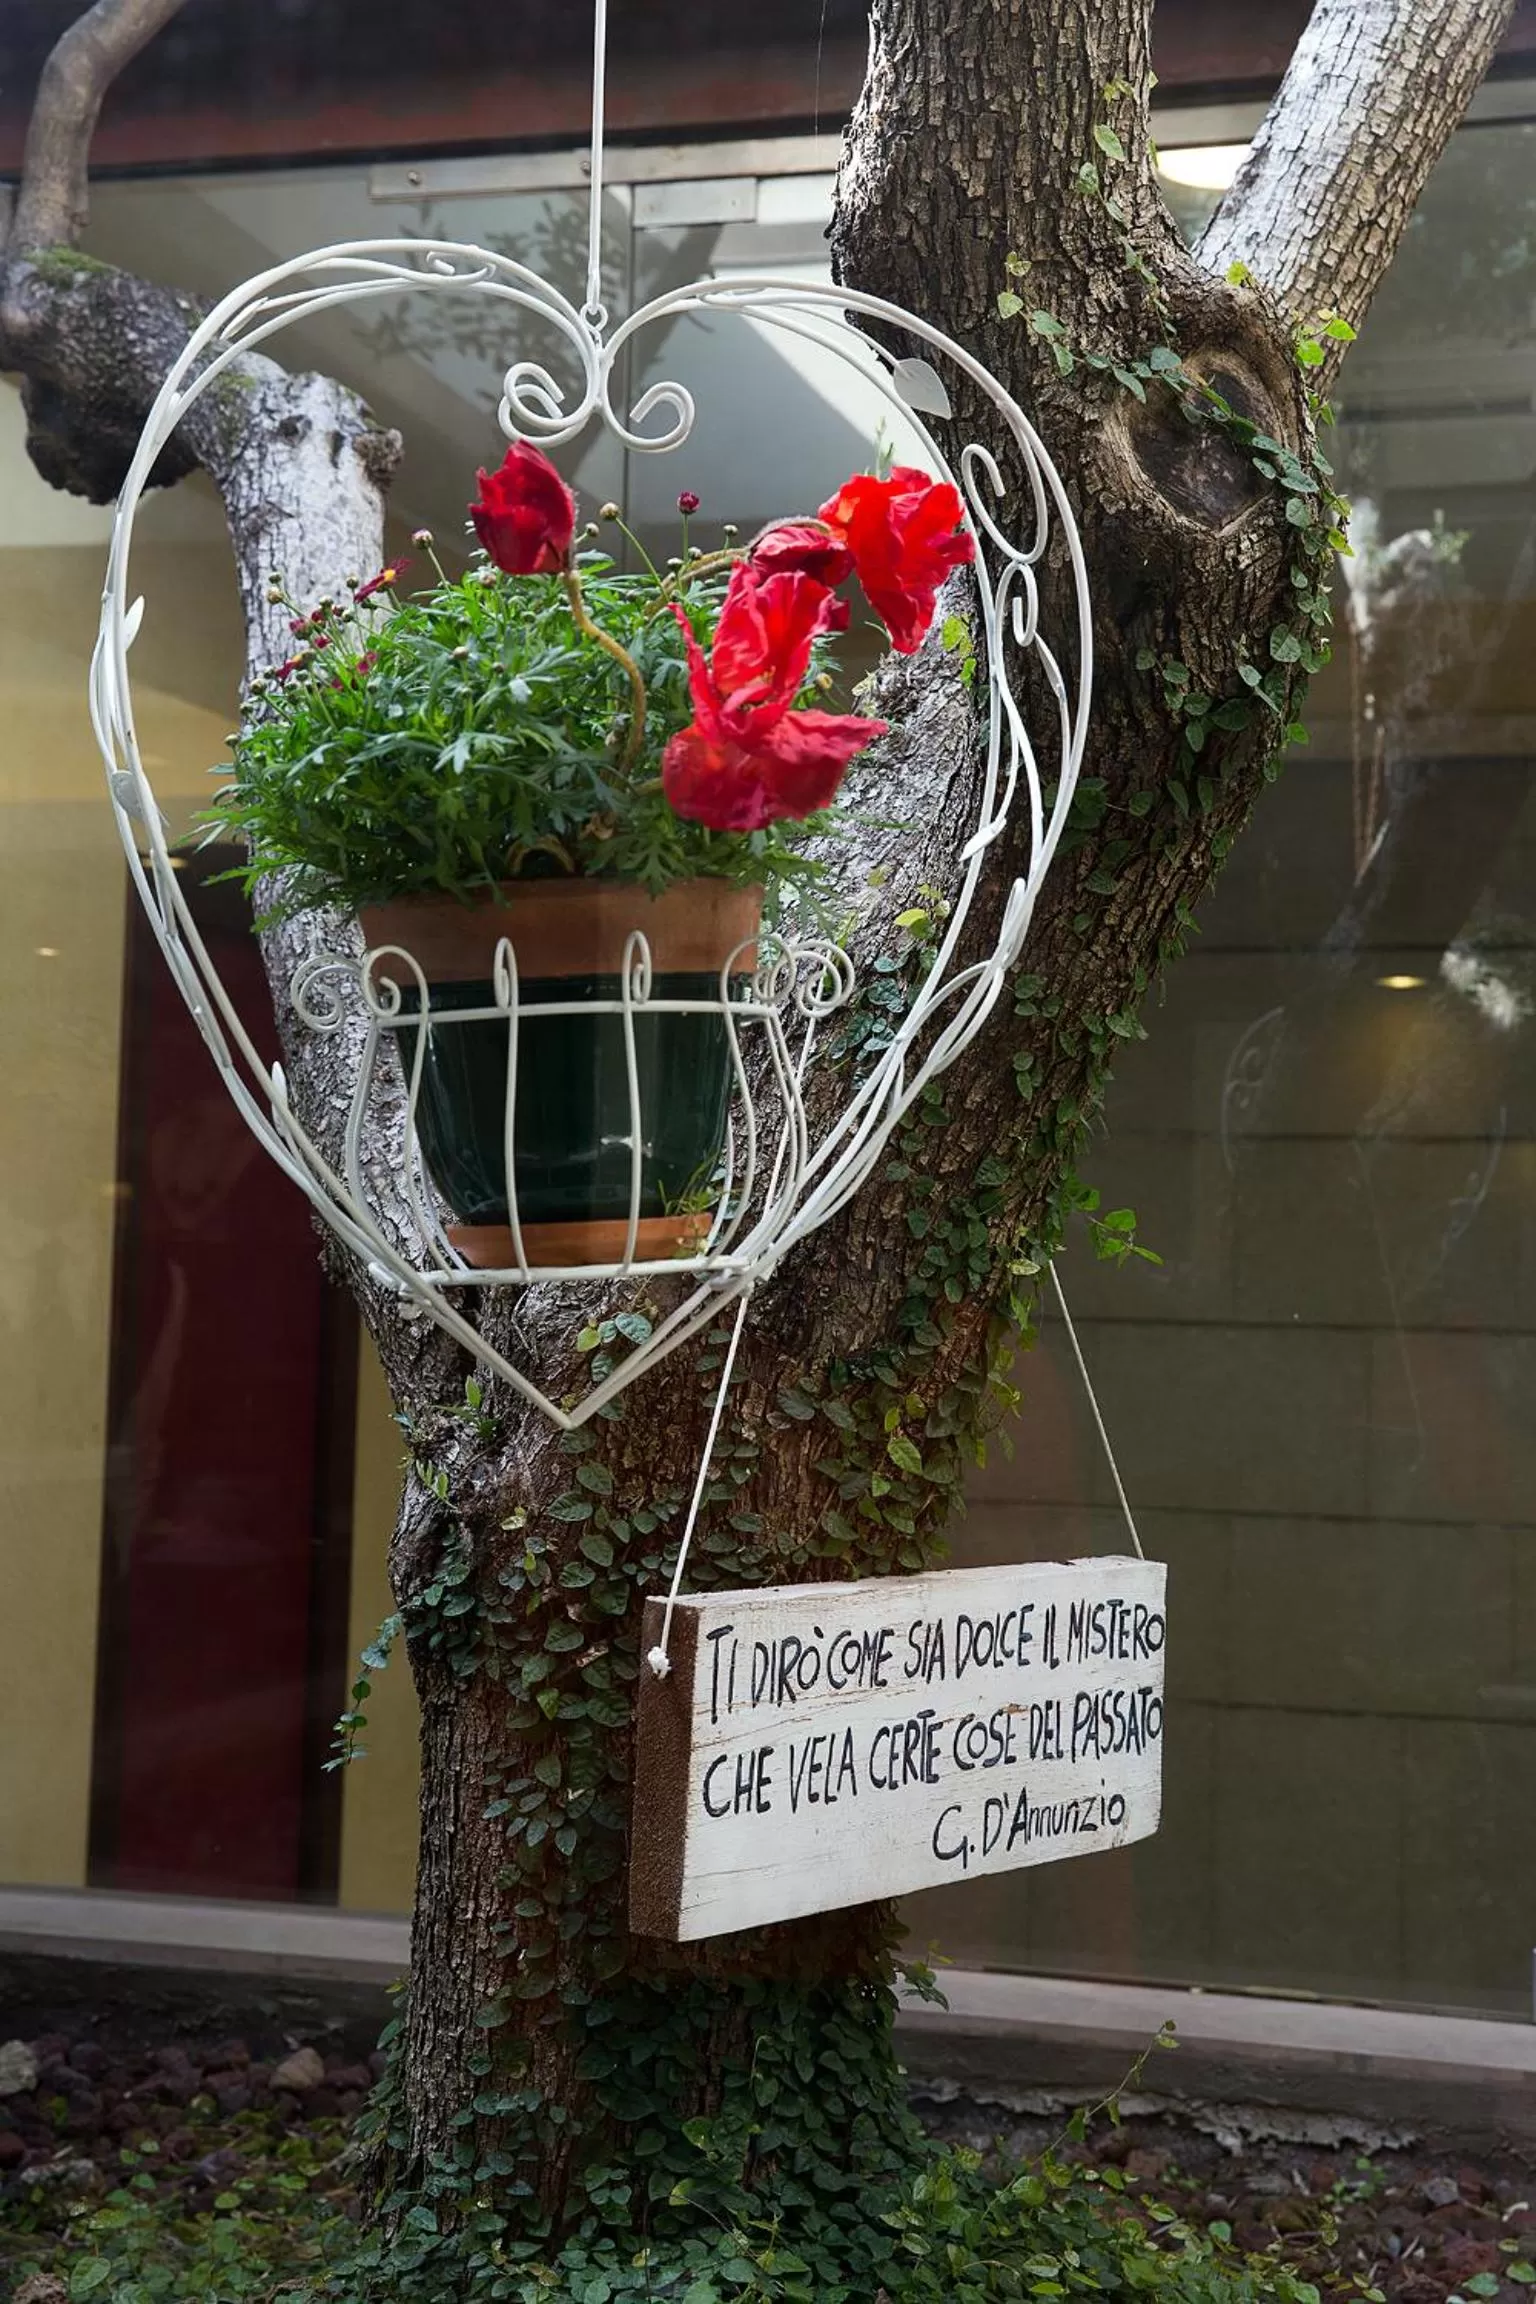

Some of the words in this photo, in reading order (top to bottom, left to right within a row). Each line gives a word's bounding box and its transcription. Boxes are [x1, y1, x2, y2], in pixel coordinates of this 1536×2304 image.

[706, 1625, 738, 1724] TI
[752, 1626, 823, 1708] DIRÒ
[827, 1629, 895, 1688] COME
[903, 1618, 945, 1685] SIA
[956, 1603, 1034, 1678] DOLCE
[1042, 1607, 1059, 1670] IL
[1067, 1599, 1165, 1662] MISTERO
[703, 1746, 775, 1818] CHE
[789, 1727, 857, 1813] VELA
[869, 1709, 943, 1791] CERTE
[953, 1704, 1017, 1770] COSE
[1029, 1697, 1063, 1761] DEL
[1071, 1685, 1163, 1764] PASSATO
[932, 1804, 975, 1868] G.
